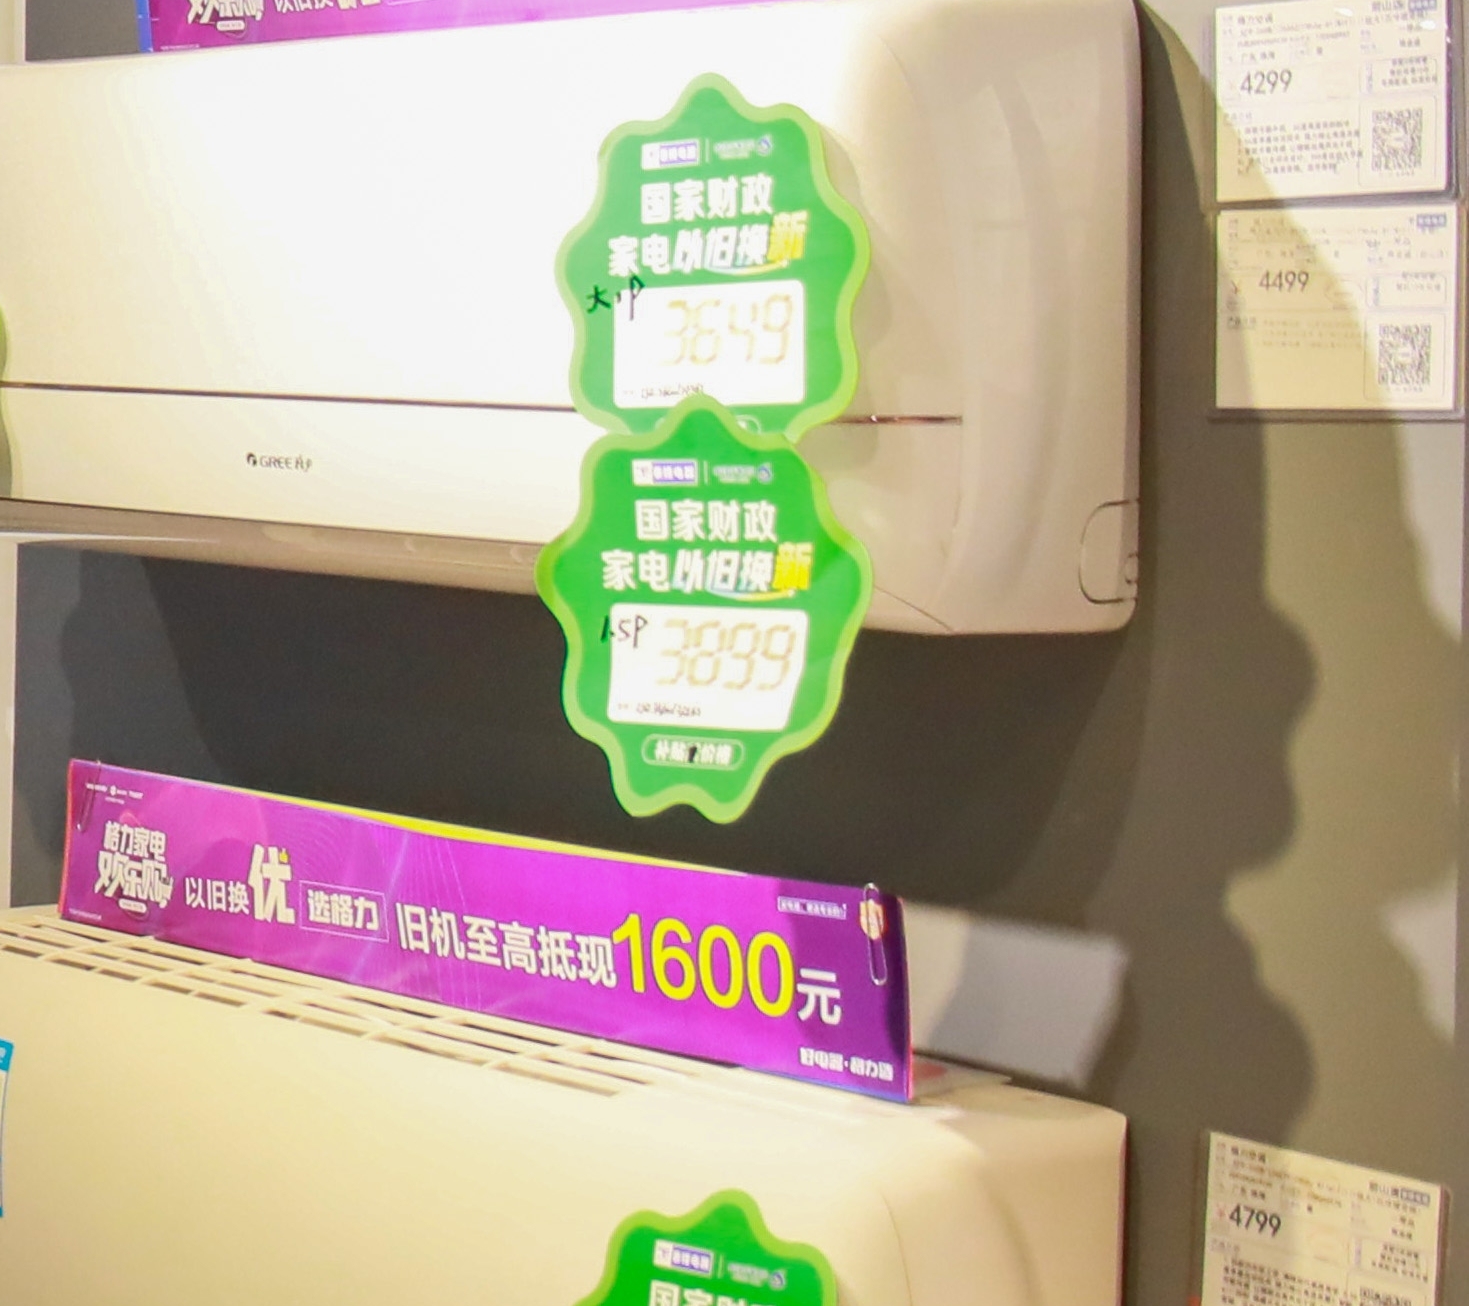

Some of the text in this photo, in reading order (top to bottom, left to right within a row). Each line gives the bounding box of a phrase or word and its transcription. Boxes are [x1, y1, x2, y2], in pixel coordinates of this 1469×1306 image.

[1240, 69, 1293, 95] 4299
[640, 174, 773, 224] 国家财政
[609, 211, 808, 277] 家电以旧换新
[1260, 270, 1309, 292] 4499
[634, 498, 776, 543] 国家财政
[601, 542, 813, 593] 家电以旧换新
[104, 820, 166, 862] 格力家电
[96, 851, 174, 900] 欢乐购
[184, 845, 844, 1027] 以旧换优 选格力 旧机至高抵现1600元
[1229, 1204, 1281, 1237] 4799
